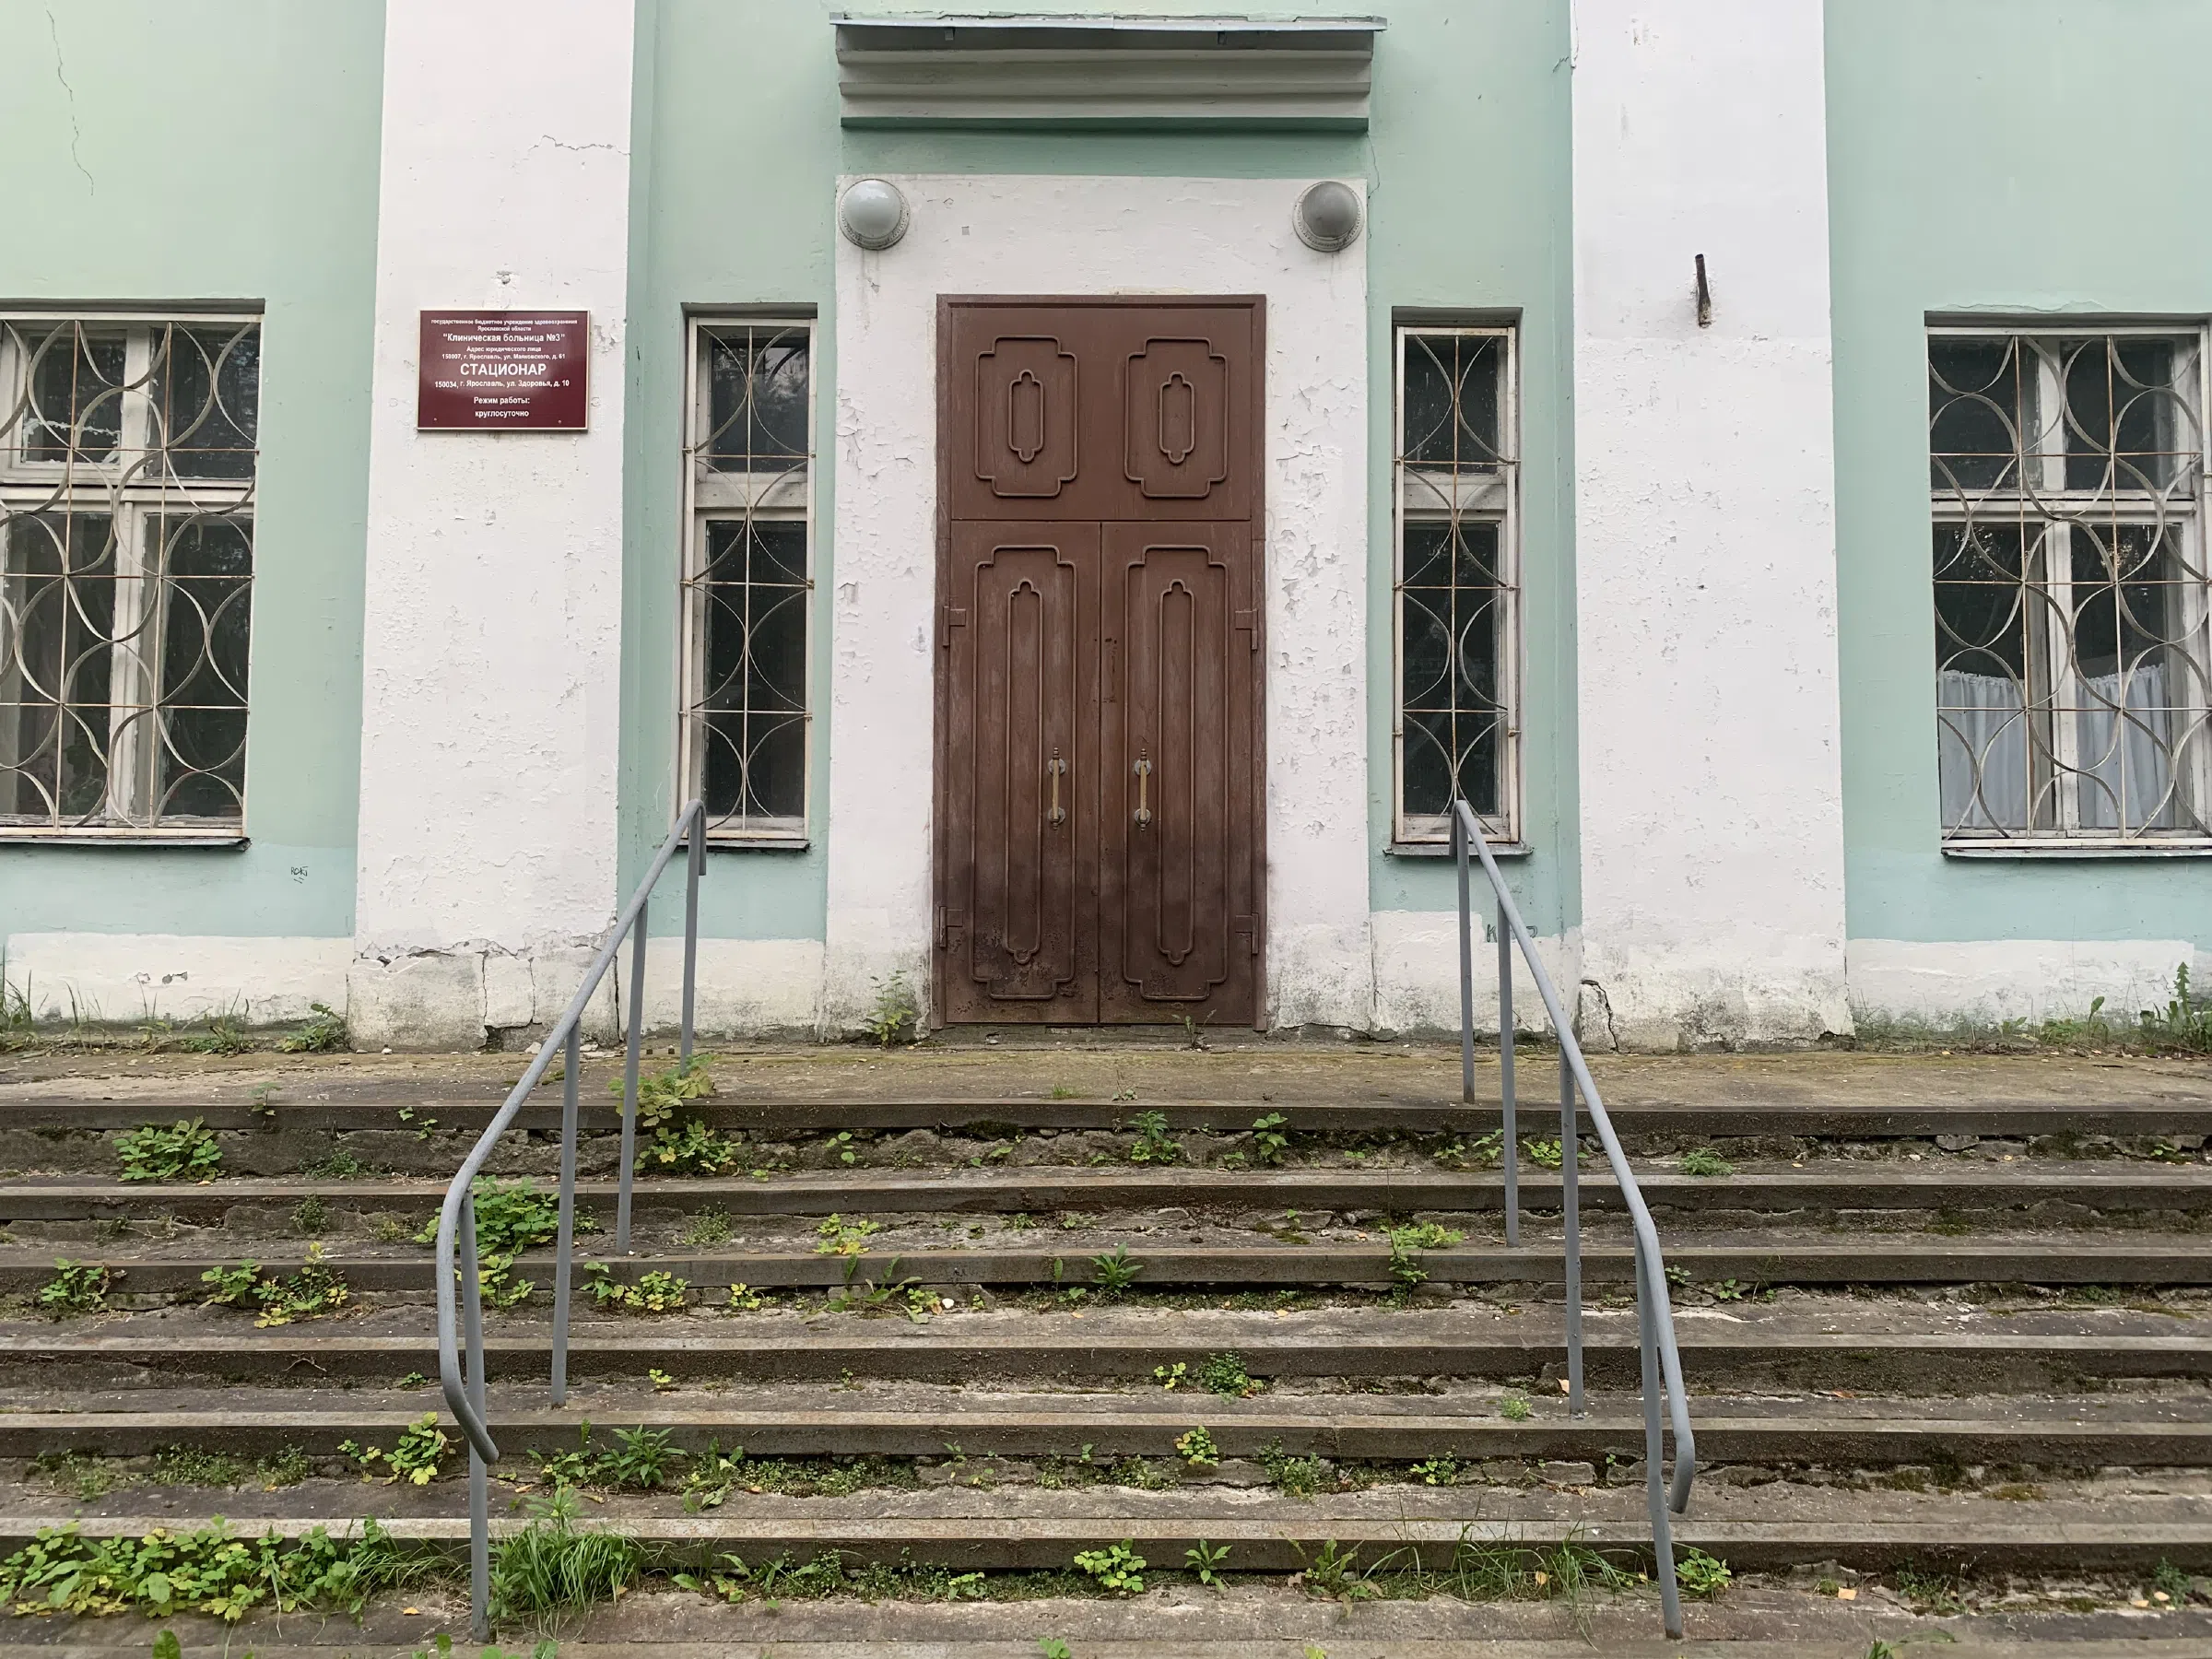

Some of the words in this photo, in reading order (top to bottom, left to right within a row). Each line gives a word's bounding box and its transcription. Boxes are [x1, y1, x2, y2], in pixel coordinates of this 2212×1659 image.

[503, 334, 544, 343] больница
[460, 363, 546, 377] СТАЦИОНАР
[500, 396, 530, 405] работы:
